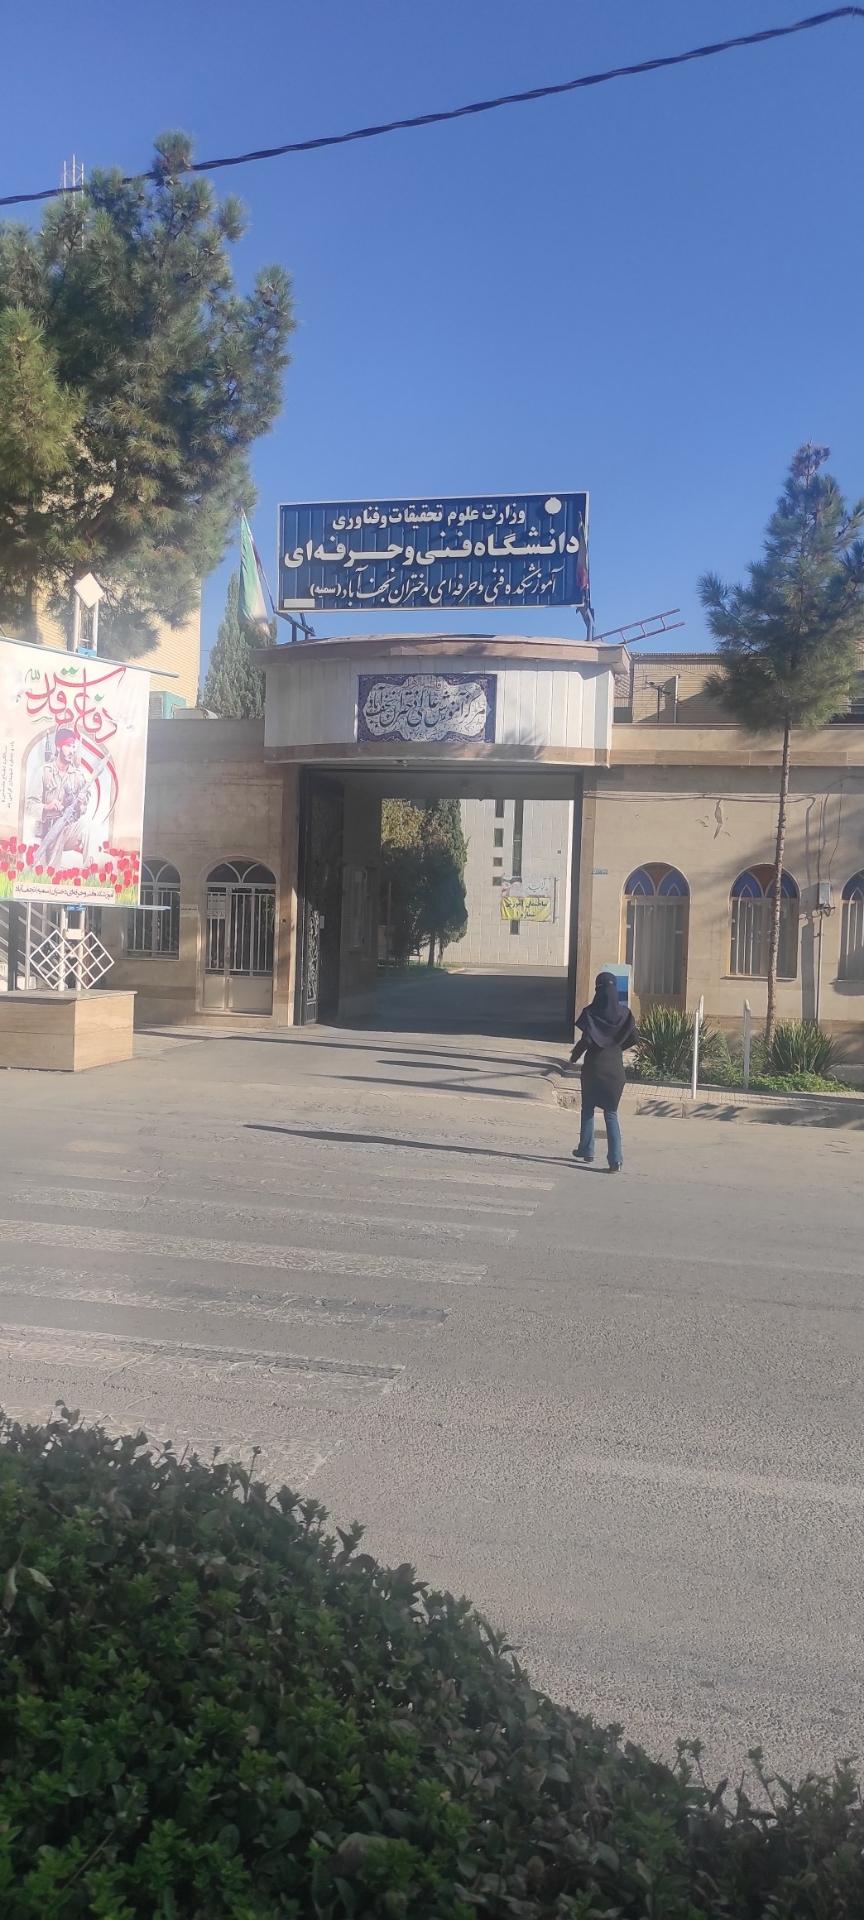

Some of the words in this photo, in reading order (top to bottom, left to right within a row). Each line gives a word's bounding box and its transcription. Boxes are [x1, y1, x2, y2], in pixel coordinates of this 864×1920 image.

[388, 504, 443, 529] تحقیقات
[447, 505, 479, 526] علوم
[482, 502, 526, 525] وزارت
[415, 531, 473, 565] فنی
[474, 526, 580, 557] دانشگاه
[309, 583, 342, 597] (سمیه)
[388, 573, 429, 604] دختران
[483, 567, 505, 603] فنی
[504, 562, 565, 595] آموزشکده
